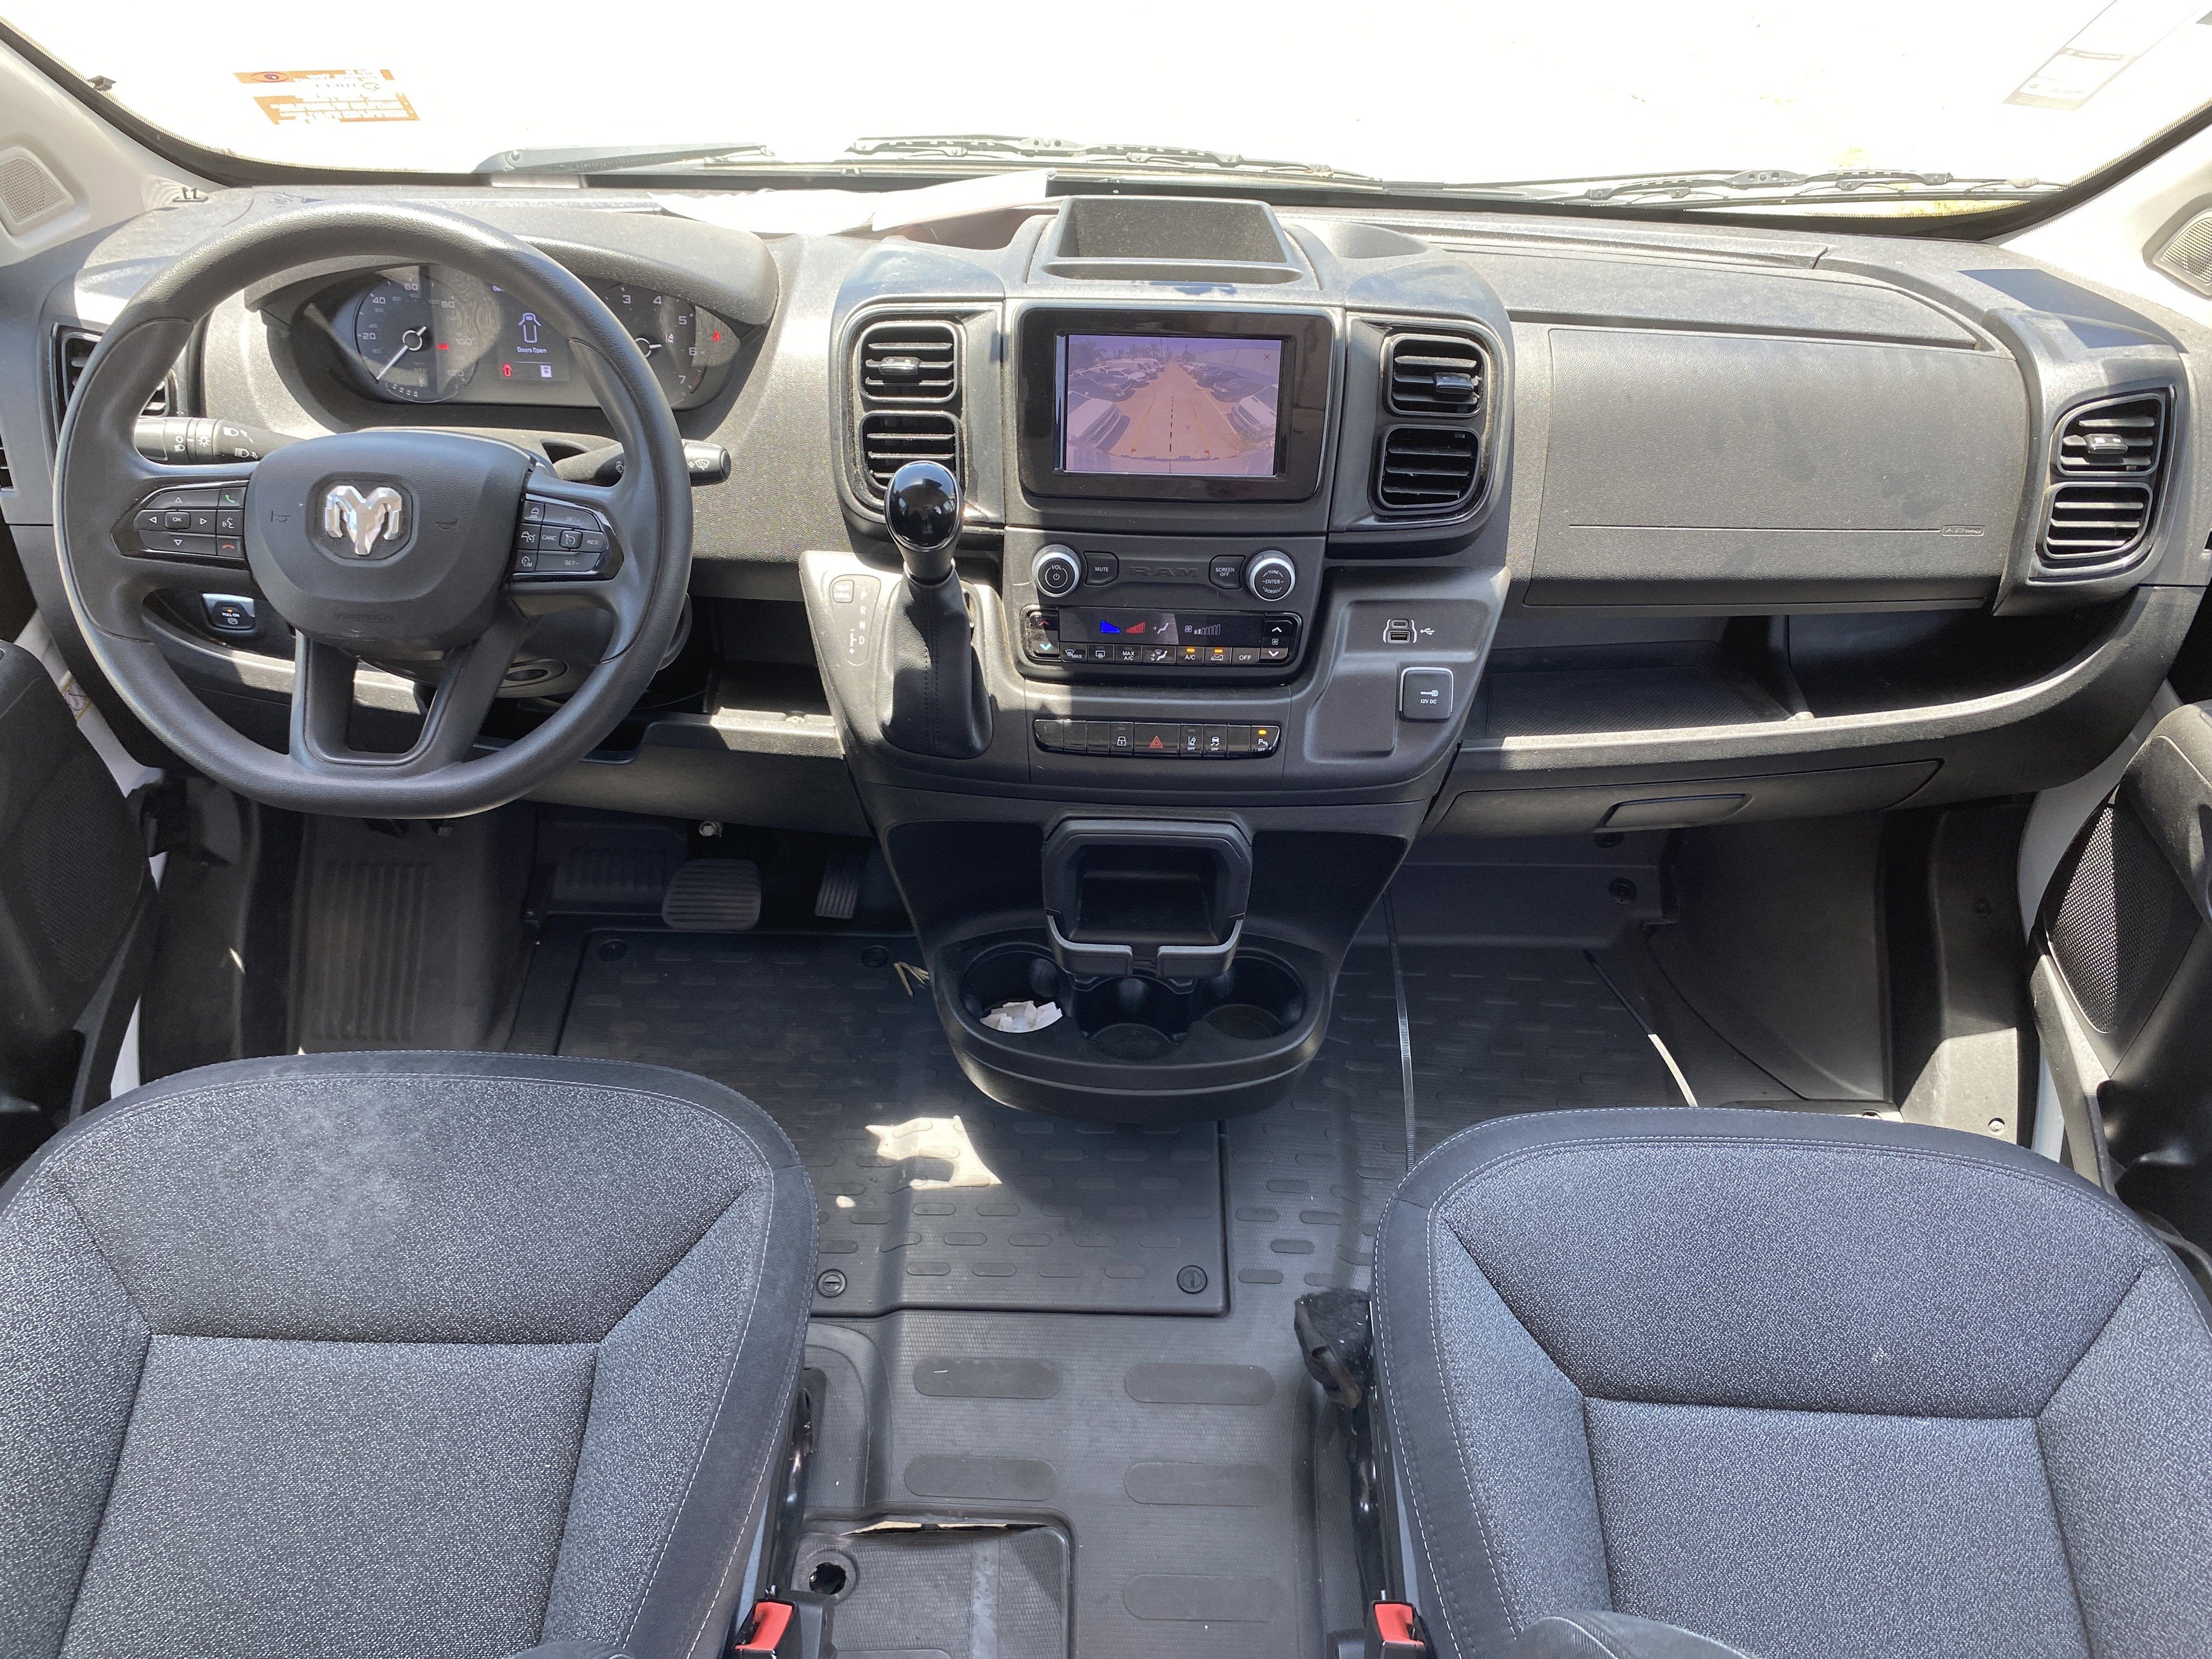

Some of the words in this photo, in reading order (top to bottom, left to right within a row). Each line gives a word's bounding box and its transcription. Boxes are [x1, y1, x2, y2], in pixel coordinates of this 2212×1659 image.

[622, 295, 631, 304] 3
[653, 296, 662, 304] 4
[678, 315, 687, 325] 5
[689, 347, 697, 356] 6
[678, 375, 686, 383] 7
[1129, 566, 1198, 577] RAM
[861, 591, 867, 600] P
[860, 605, 866, 614] R
[859, 620, 865, 630] N
[859, 635, 865, 645] D
